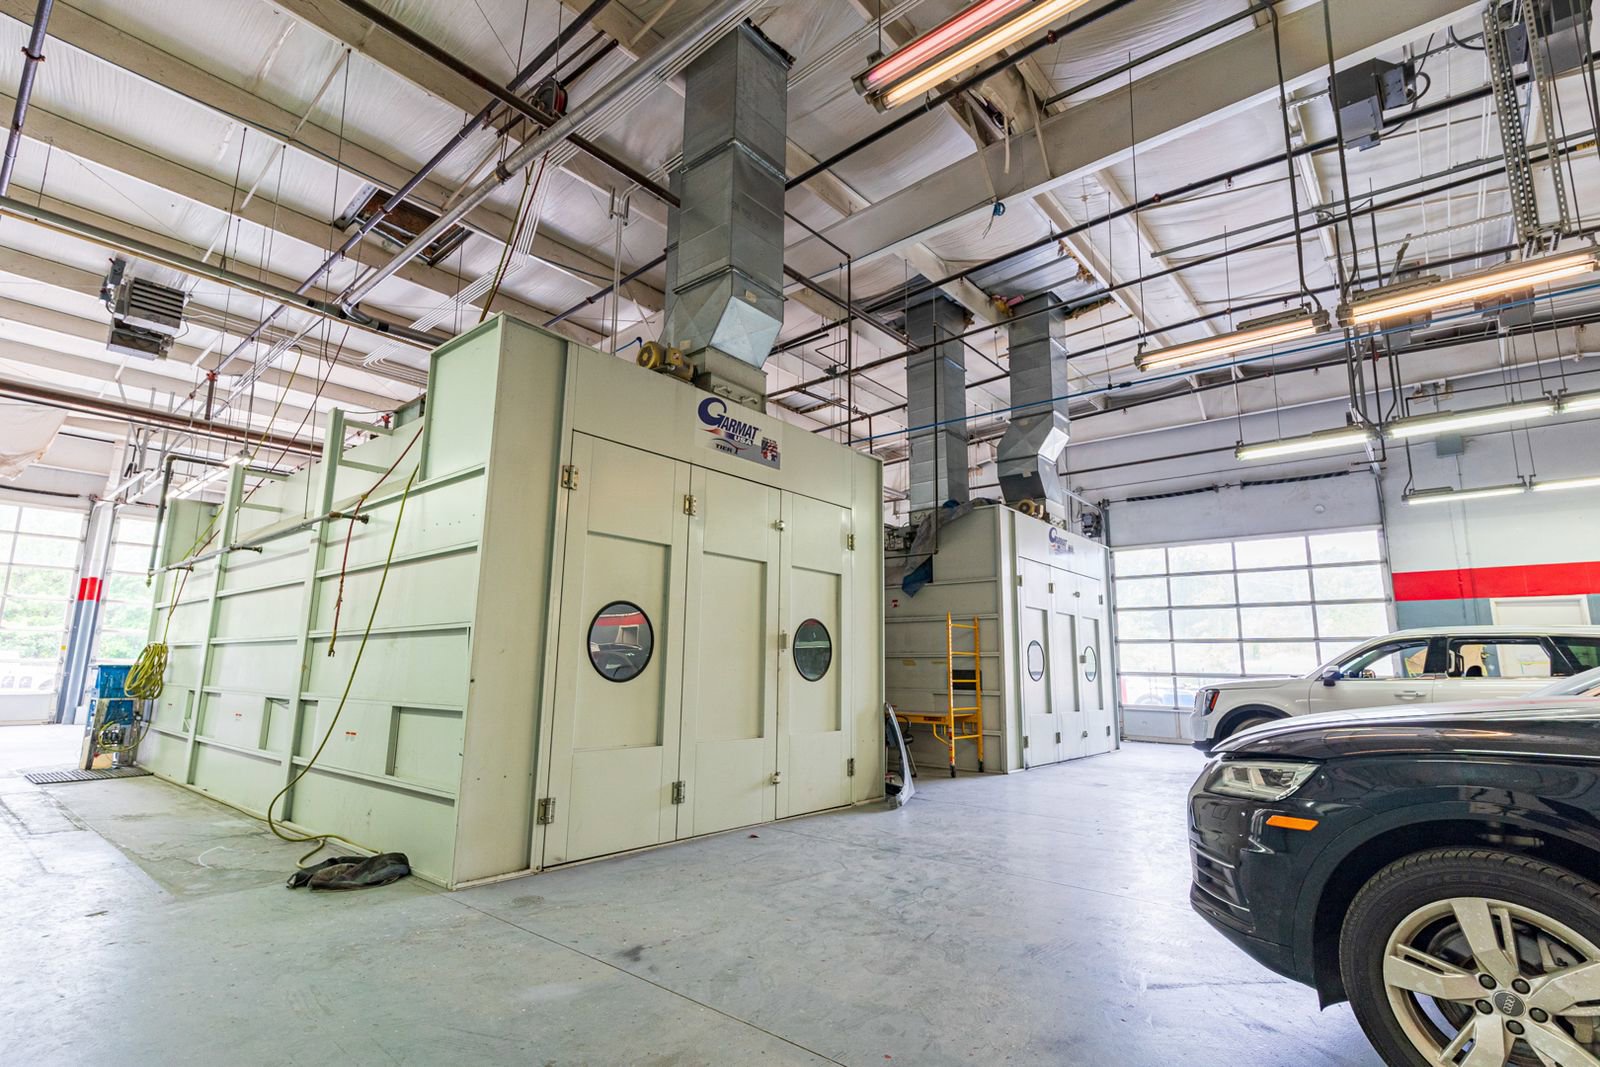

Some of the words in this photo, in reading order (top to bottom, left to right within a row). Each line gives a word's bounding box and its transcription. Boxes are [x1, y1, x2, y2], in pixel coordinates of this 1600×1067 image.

[698, 397, 760, 440] GARMAT
[734, 434, 754, 446] USA
[715, 443, 733, 453] TIER
